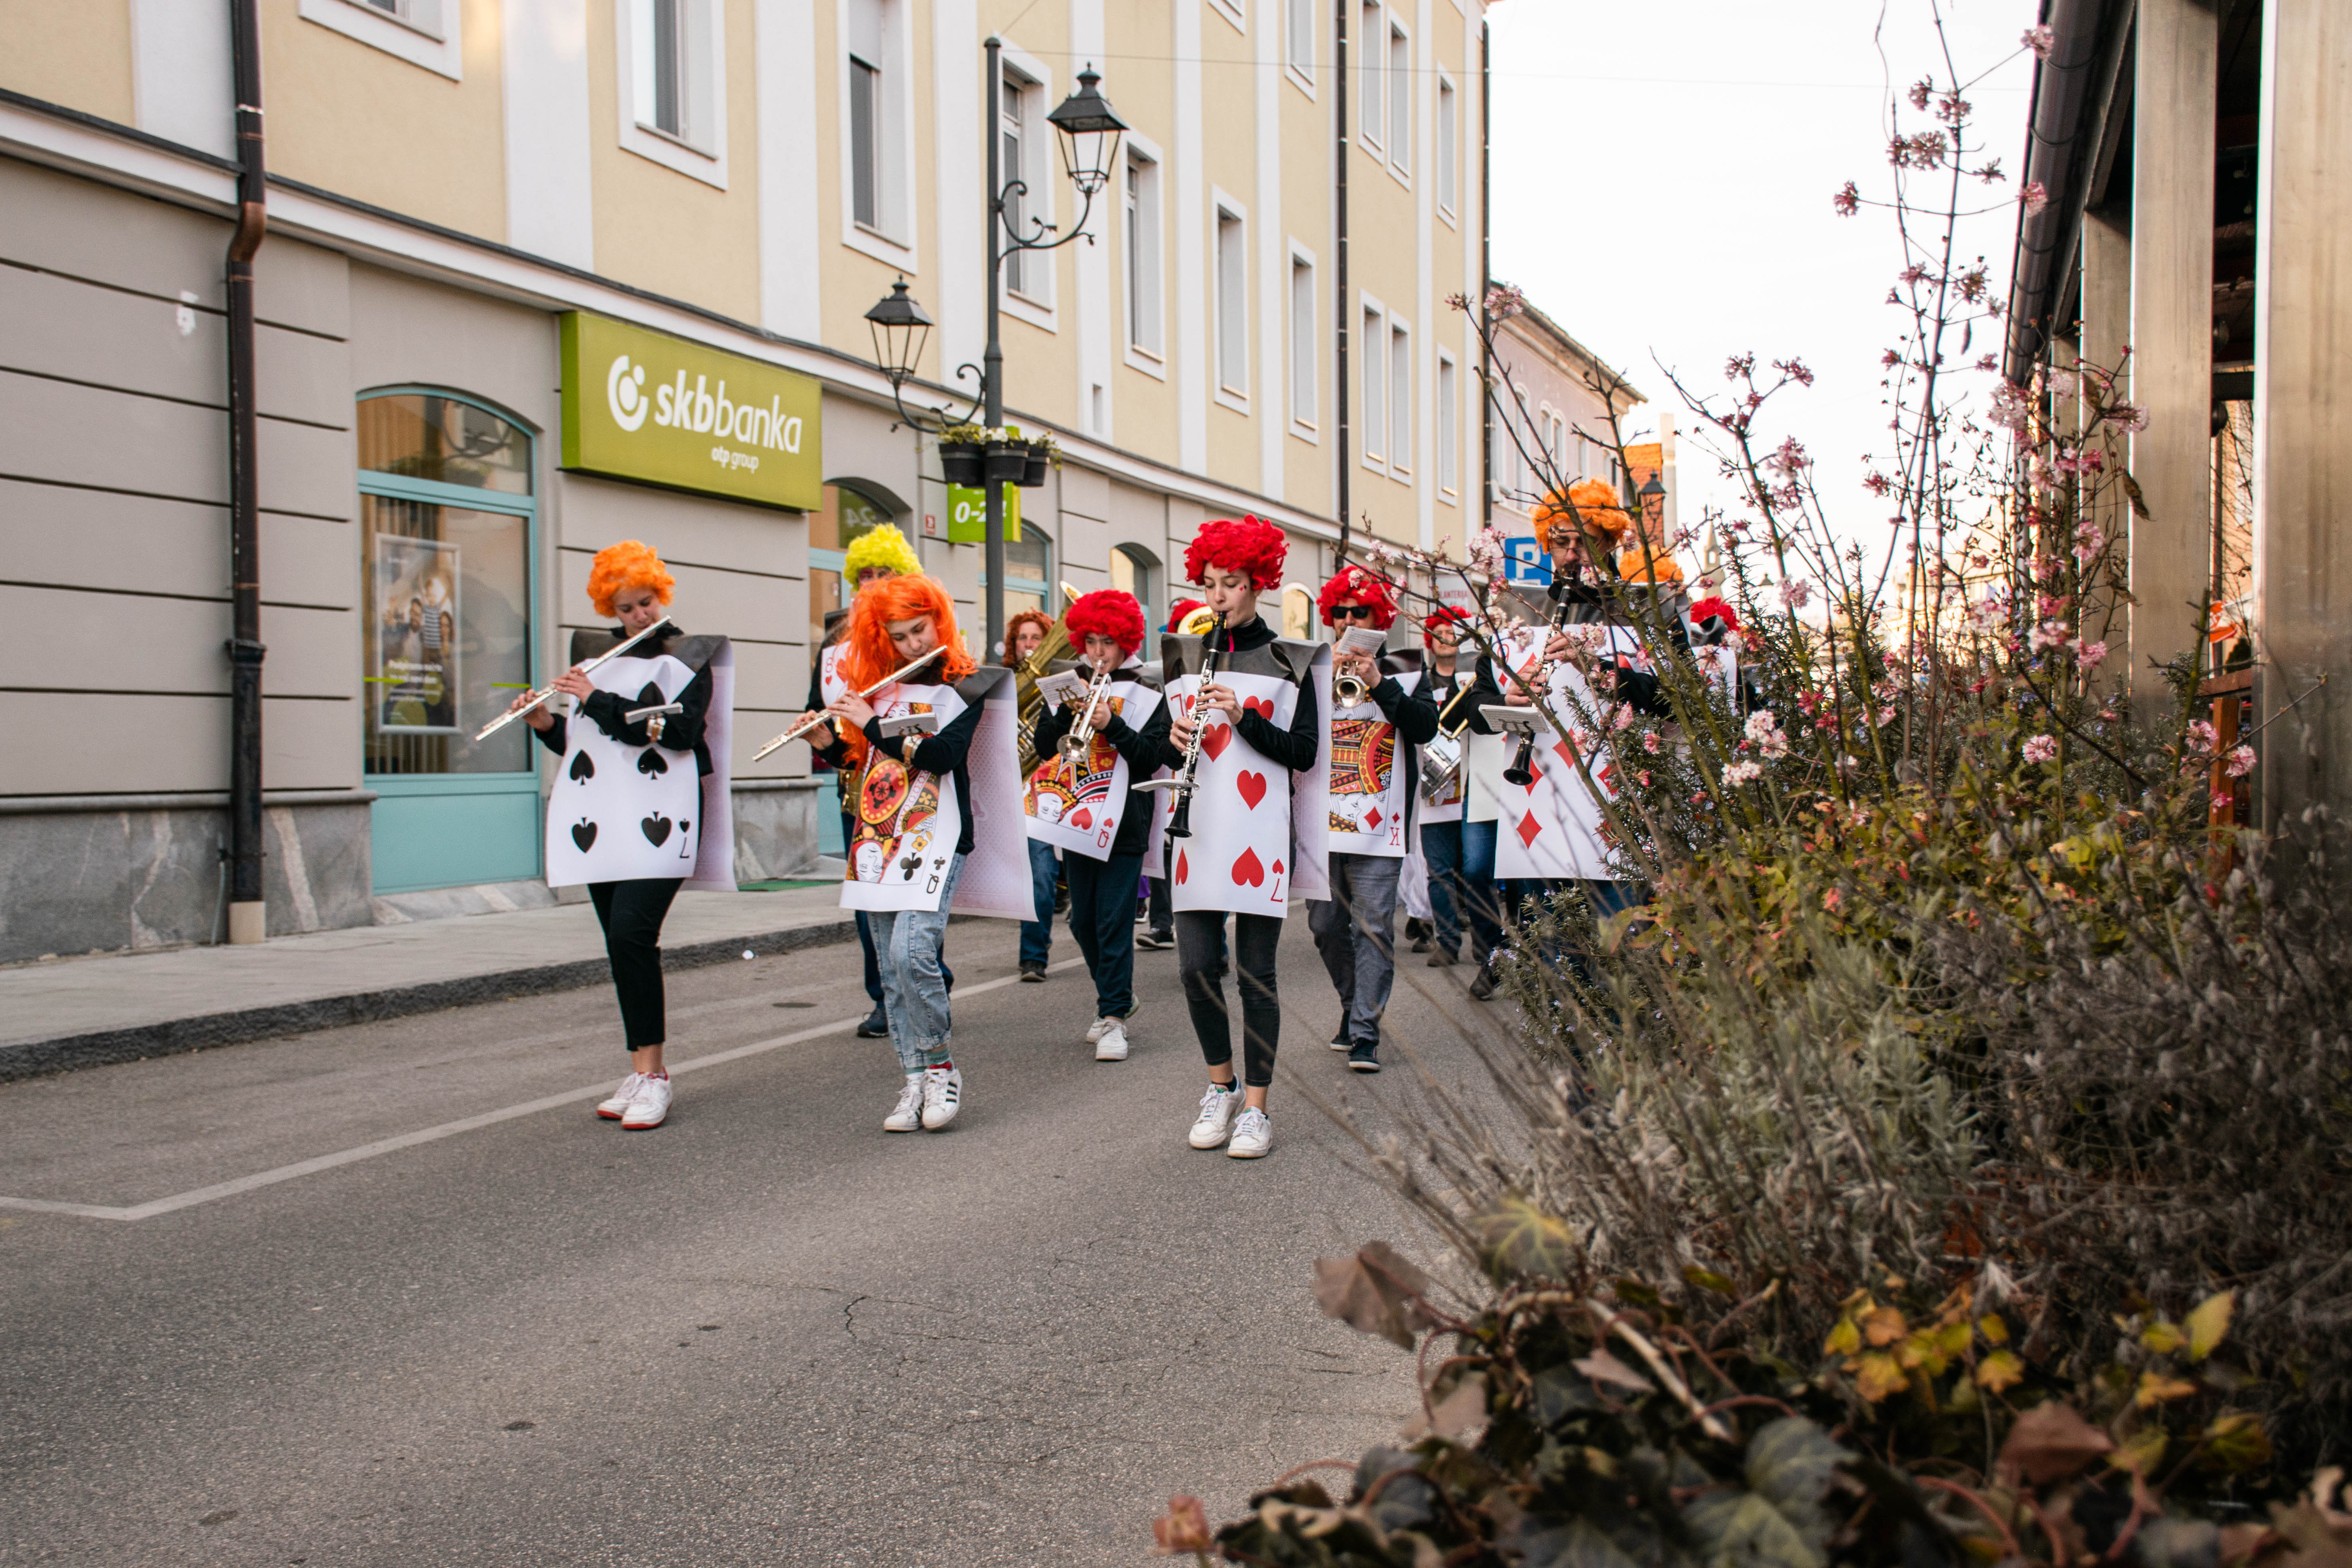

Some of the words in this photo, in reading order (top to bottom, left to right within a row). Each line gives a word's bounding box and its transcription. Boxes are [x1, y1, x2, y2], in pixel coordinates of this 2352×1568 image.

[711, 445, 730, 469] otp
[730, 451, 760, 474] group
[955, 500, 1007, 523] 0-2
[1515, 543, 1541, 578] P
[825, 657, 833, 673] 8
[1170, 693, 1185, 717] 7
[1097, 828, 1109, 848] Q
[1389, 826, 1401, 846] K
[679, 837, 690, 859] 7
[926, 874, 939, 894] Q
[1271, 878, 1283, 903] 7
